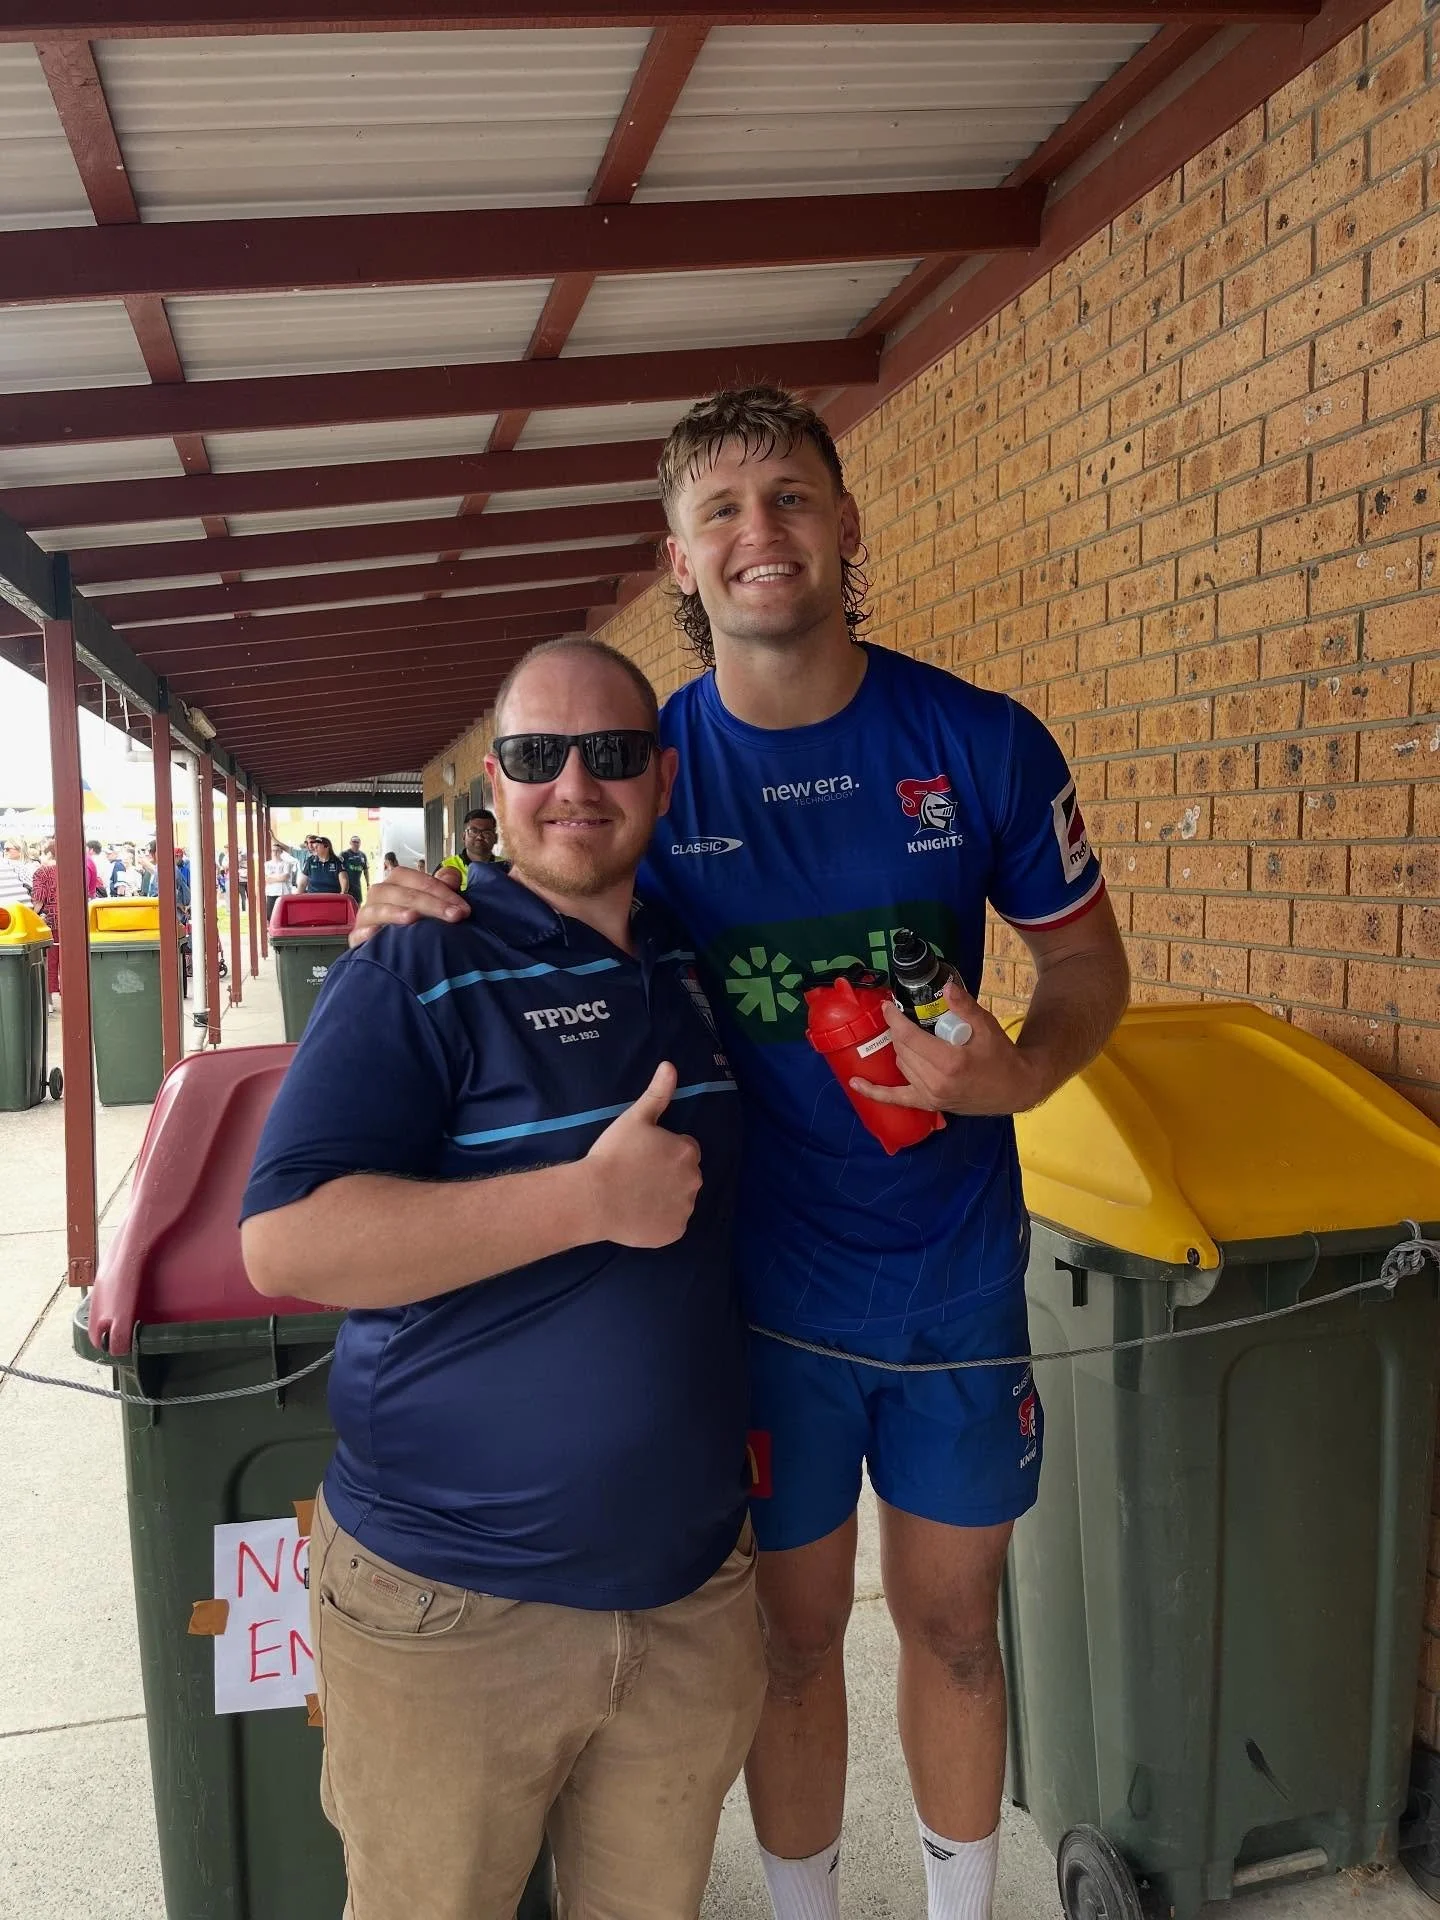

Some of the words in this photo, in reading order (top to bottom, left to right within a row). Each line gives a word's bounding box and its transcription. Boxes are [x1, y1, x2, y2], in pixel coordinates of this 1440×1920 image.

[795, 790, 853, 807] TECHNOLOGY
[671, 841, 721, 855] CLASSIC
[906, 834, 963, 853] KNIGHTS
[523, 1000, 611, 1031] TPDCC
[560, 1034, 579, 1044] Est.
[579, 1030, 600, 1040] 1923
